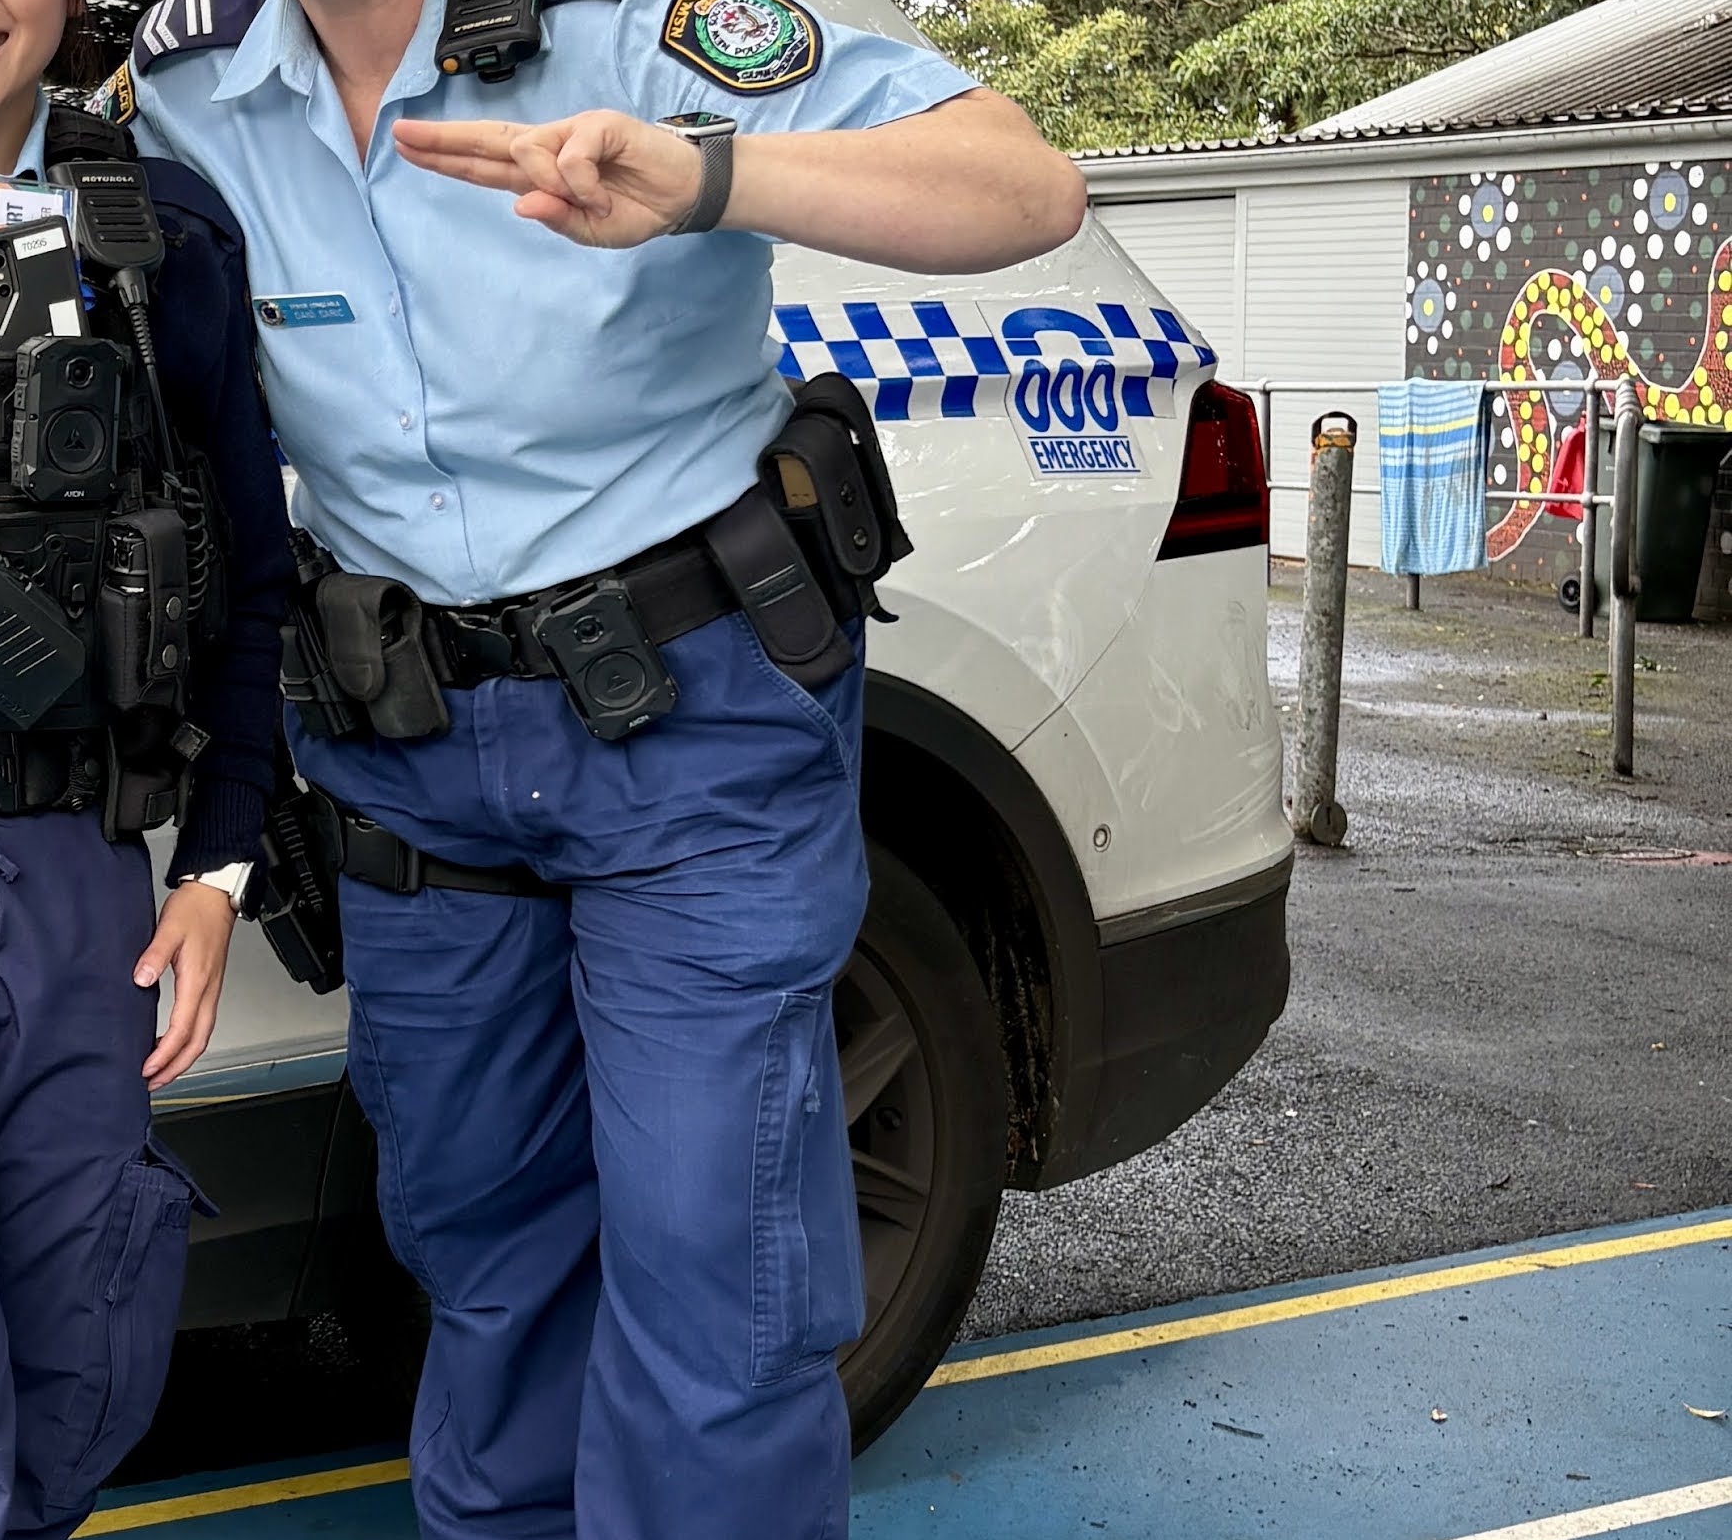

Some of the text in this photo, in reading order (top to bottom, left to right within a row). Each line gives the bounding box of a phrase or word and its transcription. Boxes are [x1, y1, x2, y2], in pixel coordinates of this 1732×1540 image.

[670, 1, 695, 39] NSW
[6, 202, 24, 225] RT
[1015, 359, 1119, 433] 000
[1030, 440, 1136, 469] EMERGENCY
